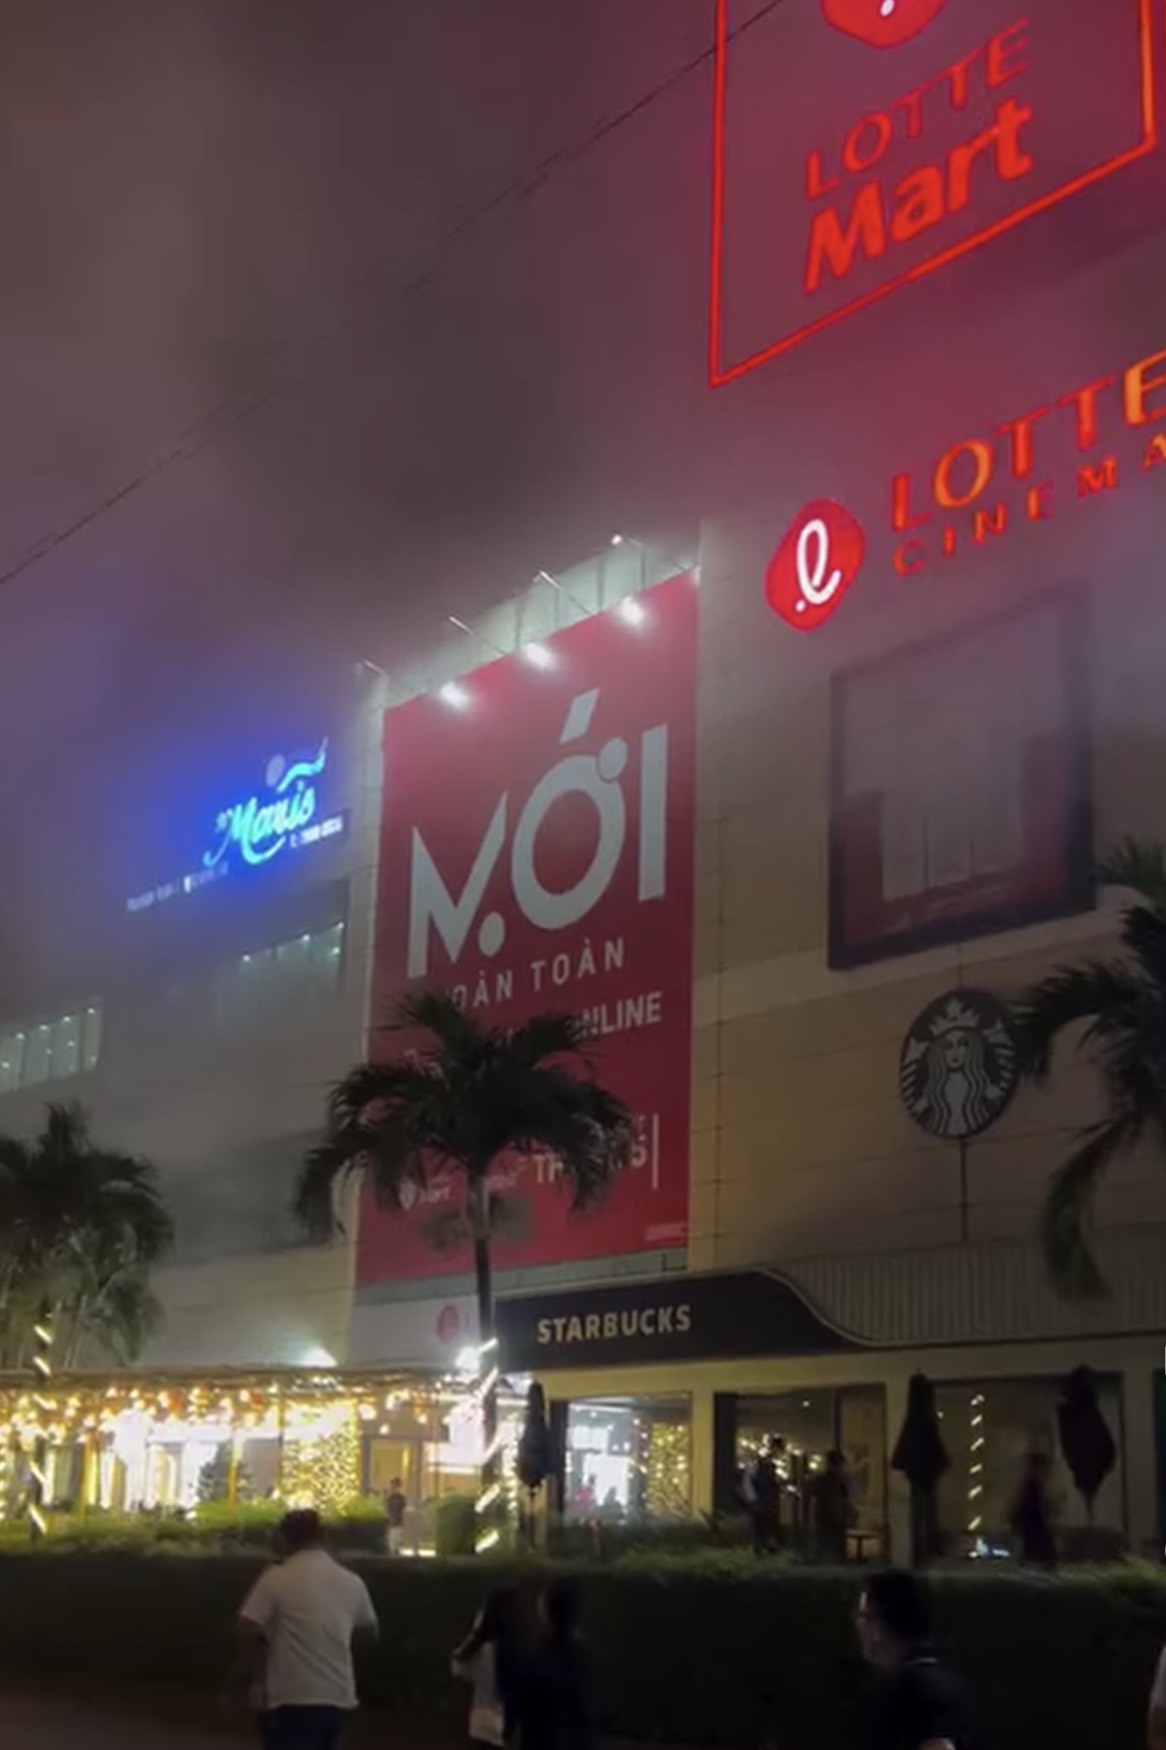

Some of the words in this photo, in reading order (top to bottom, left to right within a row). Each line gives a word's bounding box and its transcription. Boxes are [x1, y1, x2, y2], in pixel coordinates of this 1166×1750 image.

[804, 16, 1030, 199] LOTTE
[804, 97, 1033, 294] Mart
[891, 348, 1166, 533] LOTTE
[892, 432, 1166, 576] CINEMA
[447, 969, 513, 1012] OÀN
[536, 1304, 692, 1344] STARBUCKS
